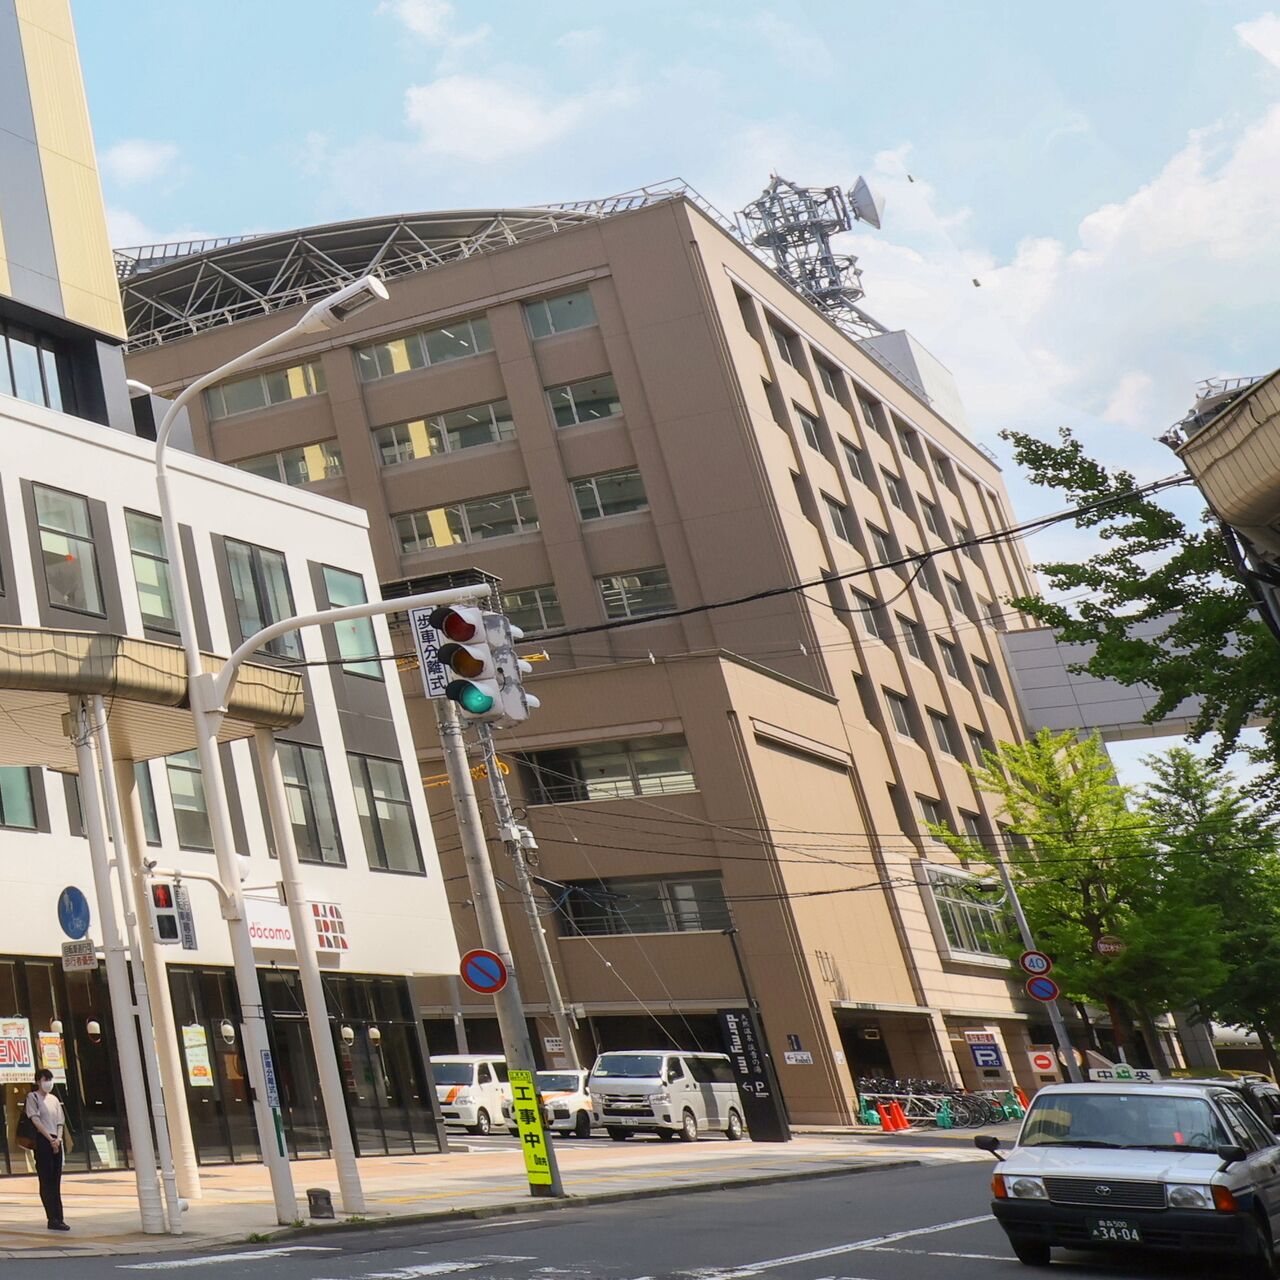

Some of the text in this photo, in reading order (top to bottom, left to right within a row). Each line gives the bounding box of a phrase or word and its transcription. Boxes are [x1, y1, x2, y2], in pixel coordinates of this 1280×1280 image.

[249, 922, 291, 940] docomo
[1027, 958, 1045, 969] 40
[726, 1014, 749, 1074] dormy inn
[974, 1050, 997, 1065] P
[755, 1081, 765, 1092] P
[514, 1086, 542, 1148] 工事中
[1099, 1227, 1140, 1241] 34-04
